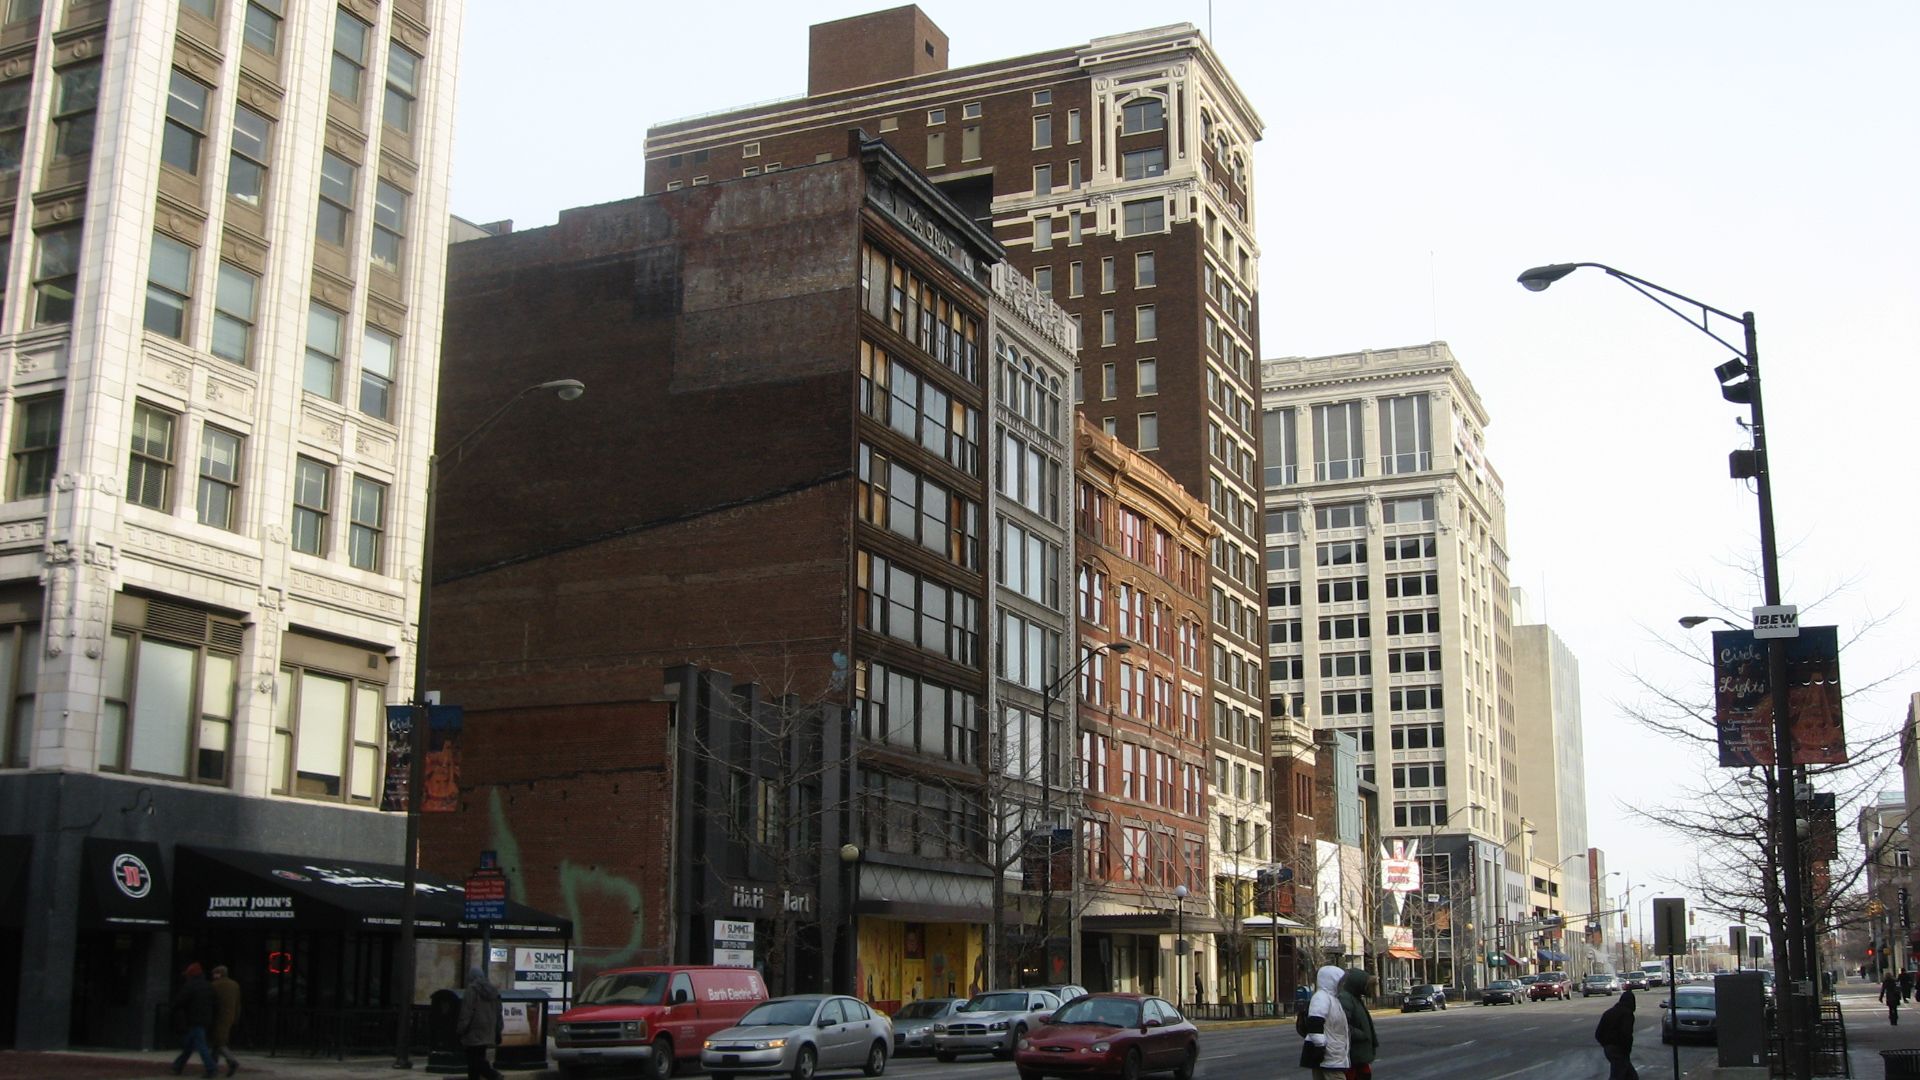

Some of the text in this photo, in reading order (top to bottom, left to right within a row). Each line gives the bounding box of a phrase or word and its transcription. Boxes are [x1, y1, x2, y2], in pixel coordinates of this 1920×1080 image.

[1754, 613, 1797, 625] IBEW
[1720, 645, 1760, 663] Circle
[1718, 676, 1766, 698] Lights
[209, 897, 292, 909] JIMMY JOHN'S
[534, 952, 565, 963] SUMMIT
[708, 988, 752, 1001] Barth Electric
